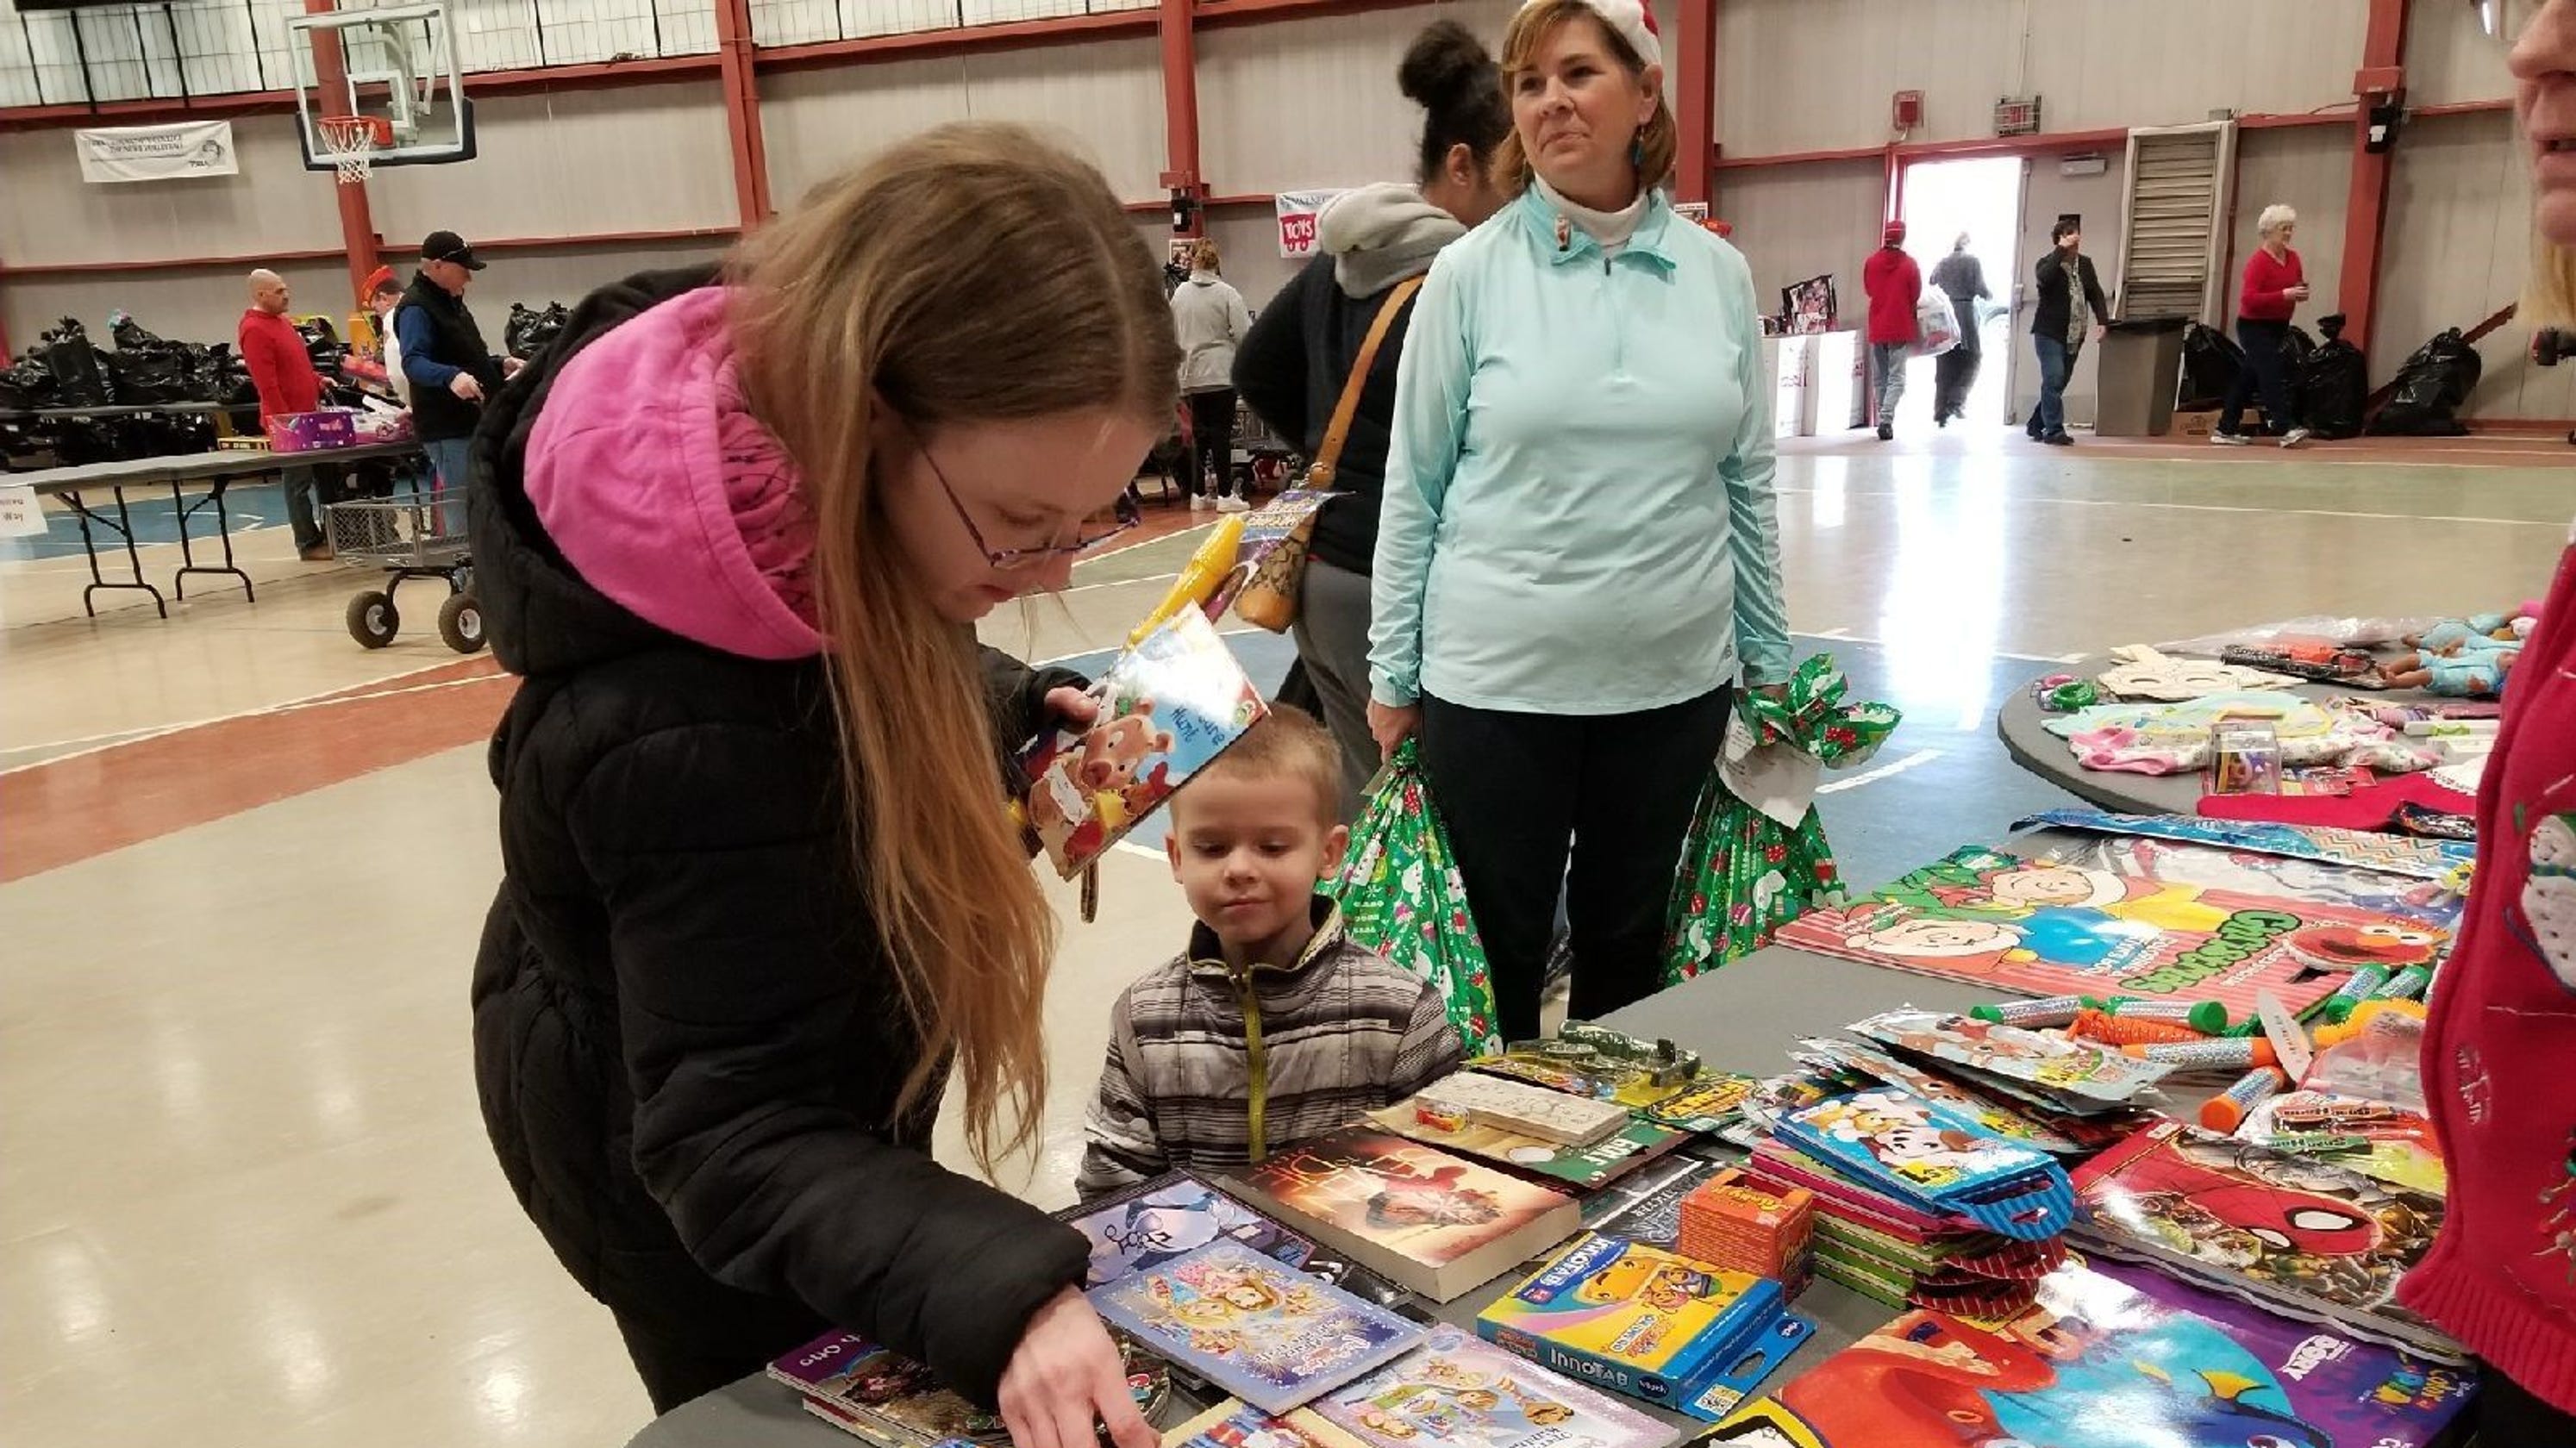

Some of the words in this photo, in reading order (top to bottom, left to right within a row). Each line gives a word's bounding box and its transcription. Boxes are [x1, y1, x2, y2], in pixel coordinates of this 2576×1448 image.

[1285, 217, 1313, 239] TOYS
[1170, 705, 1200, 743] Hunt
[2283, 1335, 2340, 1382] DORY
